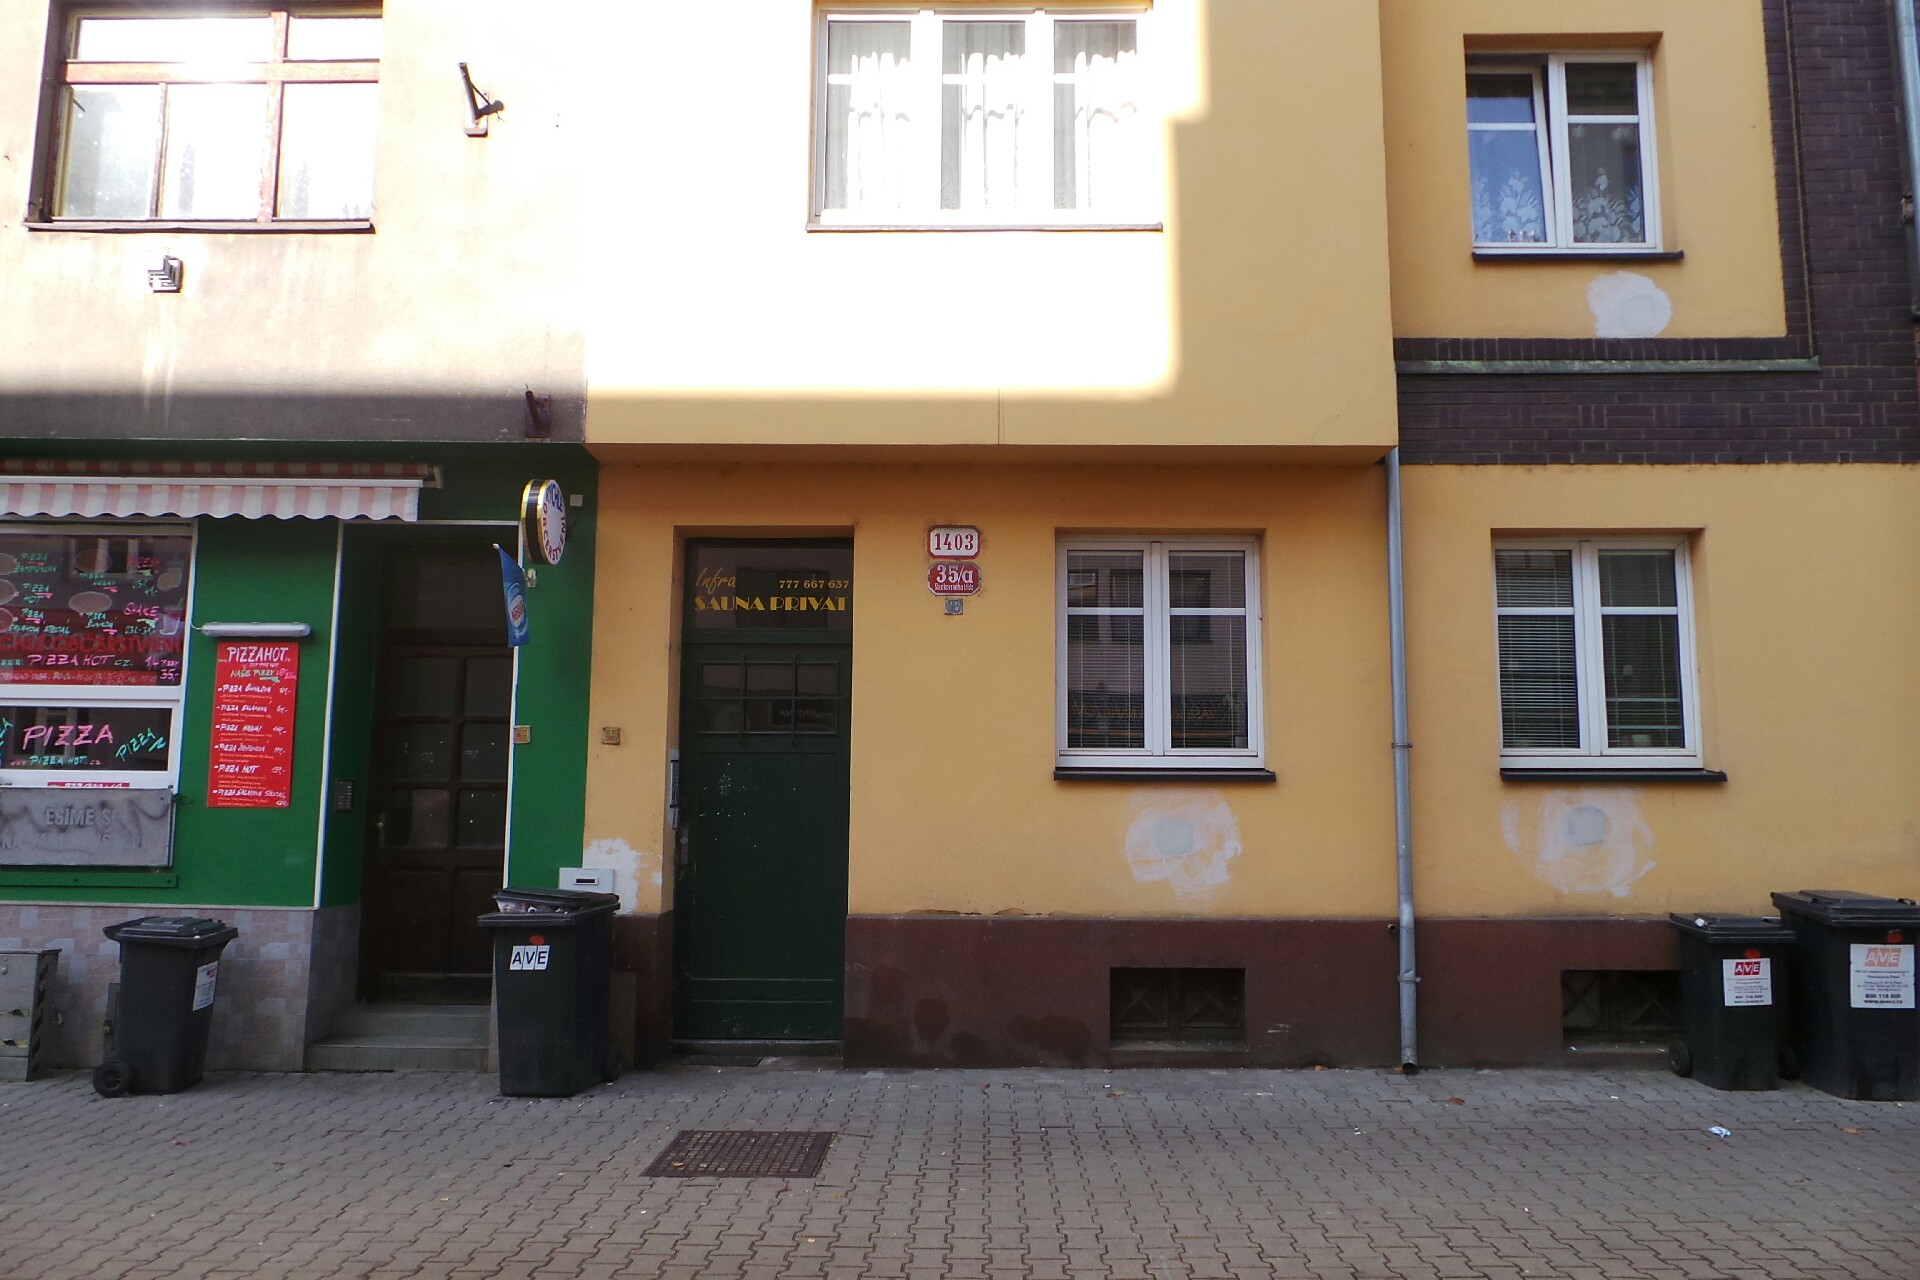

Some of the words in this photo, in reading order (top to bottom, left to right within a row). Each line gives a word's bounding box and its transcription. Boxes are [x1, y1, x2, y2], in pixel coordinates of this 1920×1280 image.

[934, 532, 974, 551] 1403
[695, 567, 737, 594] Infra
[936, 564, 974, 584] 35/a
[779, 580, 799, 589] 777
[803, 580, 824, 589] 667
[828, 580, 850, 589] 637
[694, 596, 765, 611] SAUNA
[769, 596, 849, 611] PRIVAT
[27, 654, 79, 667] PIZZA
[83, 654, 116, 667] HOT
[222, 684, 242, 693] PIZZA
[220, 704, 239, 712] PIZZA
[219, 724, 238, 732] PIZZA
[22, 723, 114, 751] PIZZA
[115, 727, 156, 763] PIZZA
[218, 743, 237, 752] PIZZA
[29, 755, 64, 766] PIZZA
[218, 764, 239, 773] PIZZA
[241, 765, 260, 774] HOT
[511, 950, 549, 965] AVE
[1866, 951, 1901, 964] AVE
[1735, 963, 1761, 973] AVE
